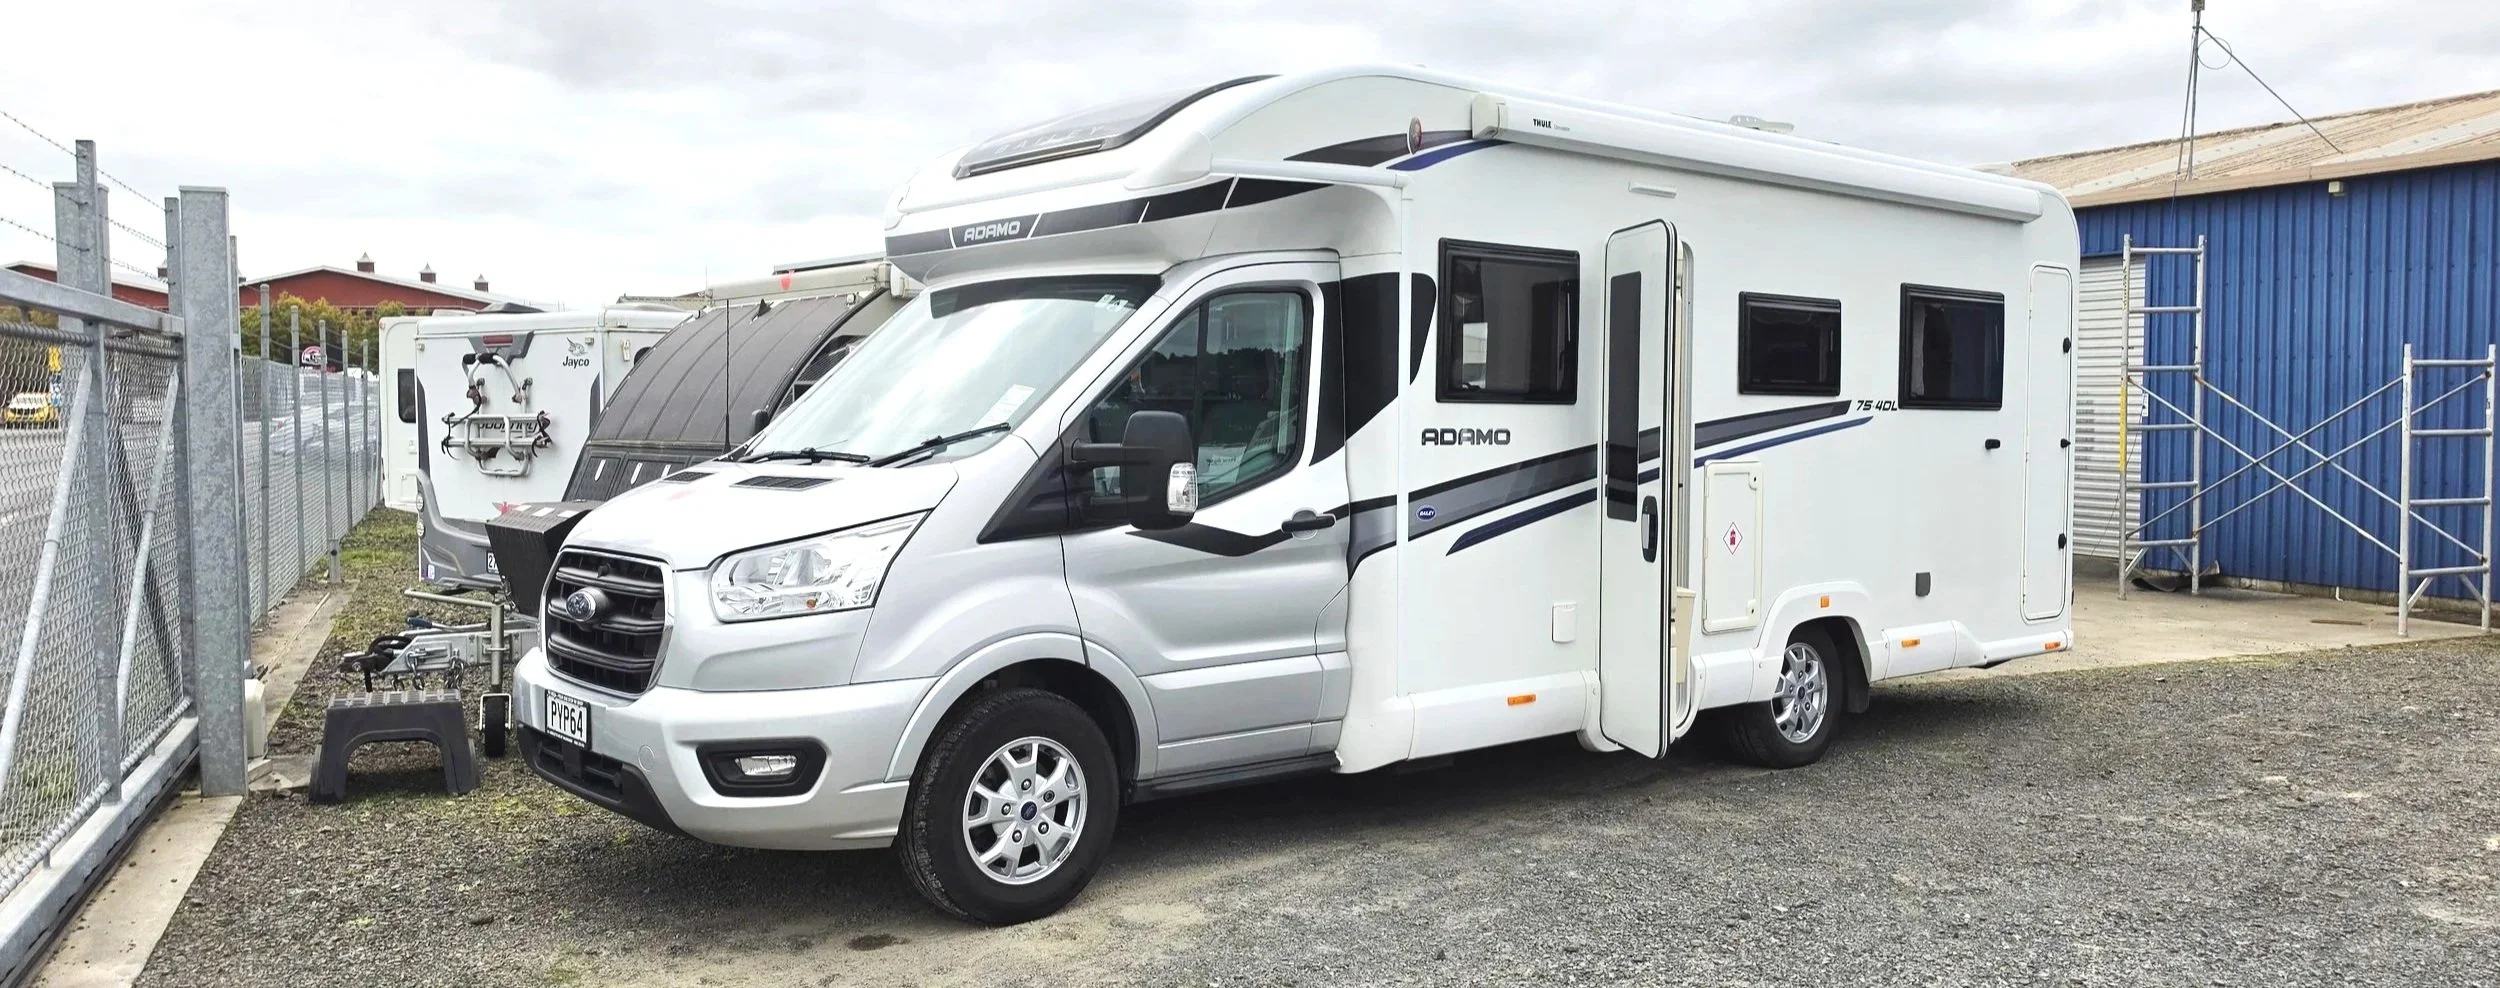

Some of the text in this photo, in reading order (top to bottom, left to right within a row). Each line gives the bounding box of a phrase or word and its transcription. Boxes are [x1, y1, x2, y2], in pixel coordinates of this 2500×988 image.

[1533, 118, 1552, 129] THULE
[964, 220, 1021, 242] ADAMO
[562, 355, 590, 369] Jayco
[1421, 428, 1511, 446] ADAMO
[551, 700, 583, 738] PYP64
